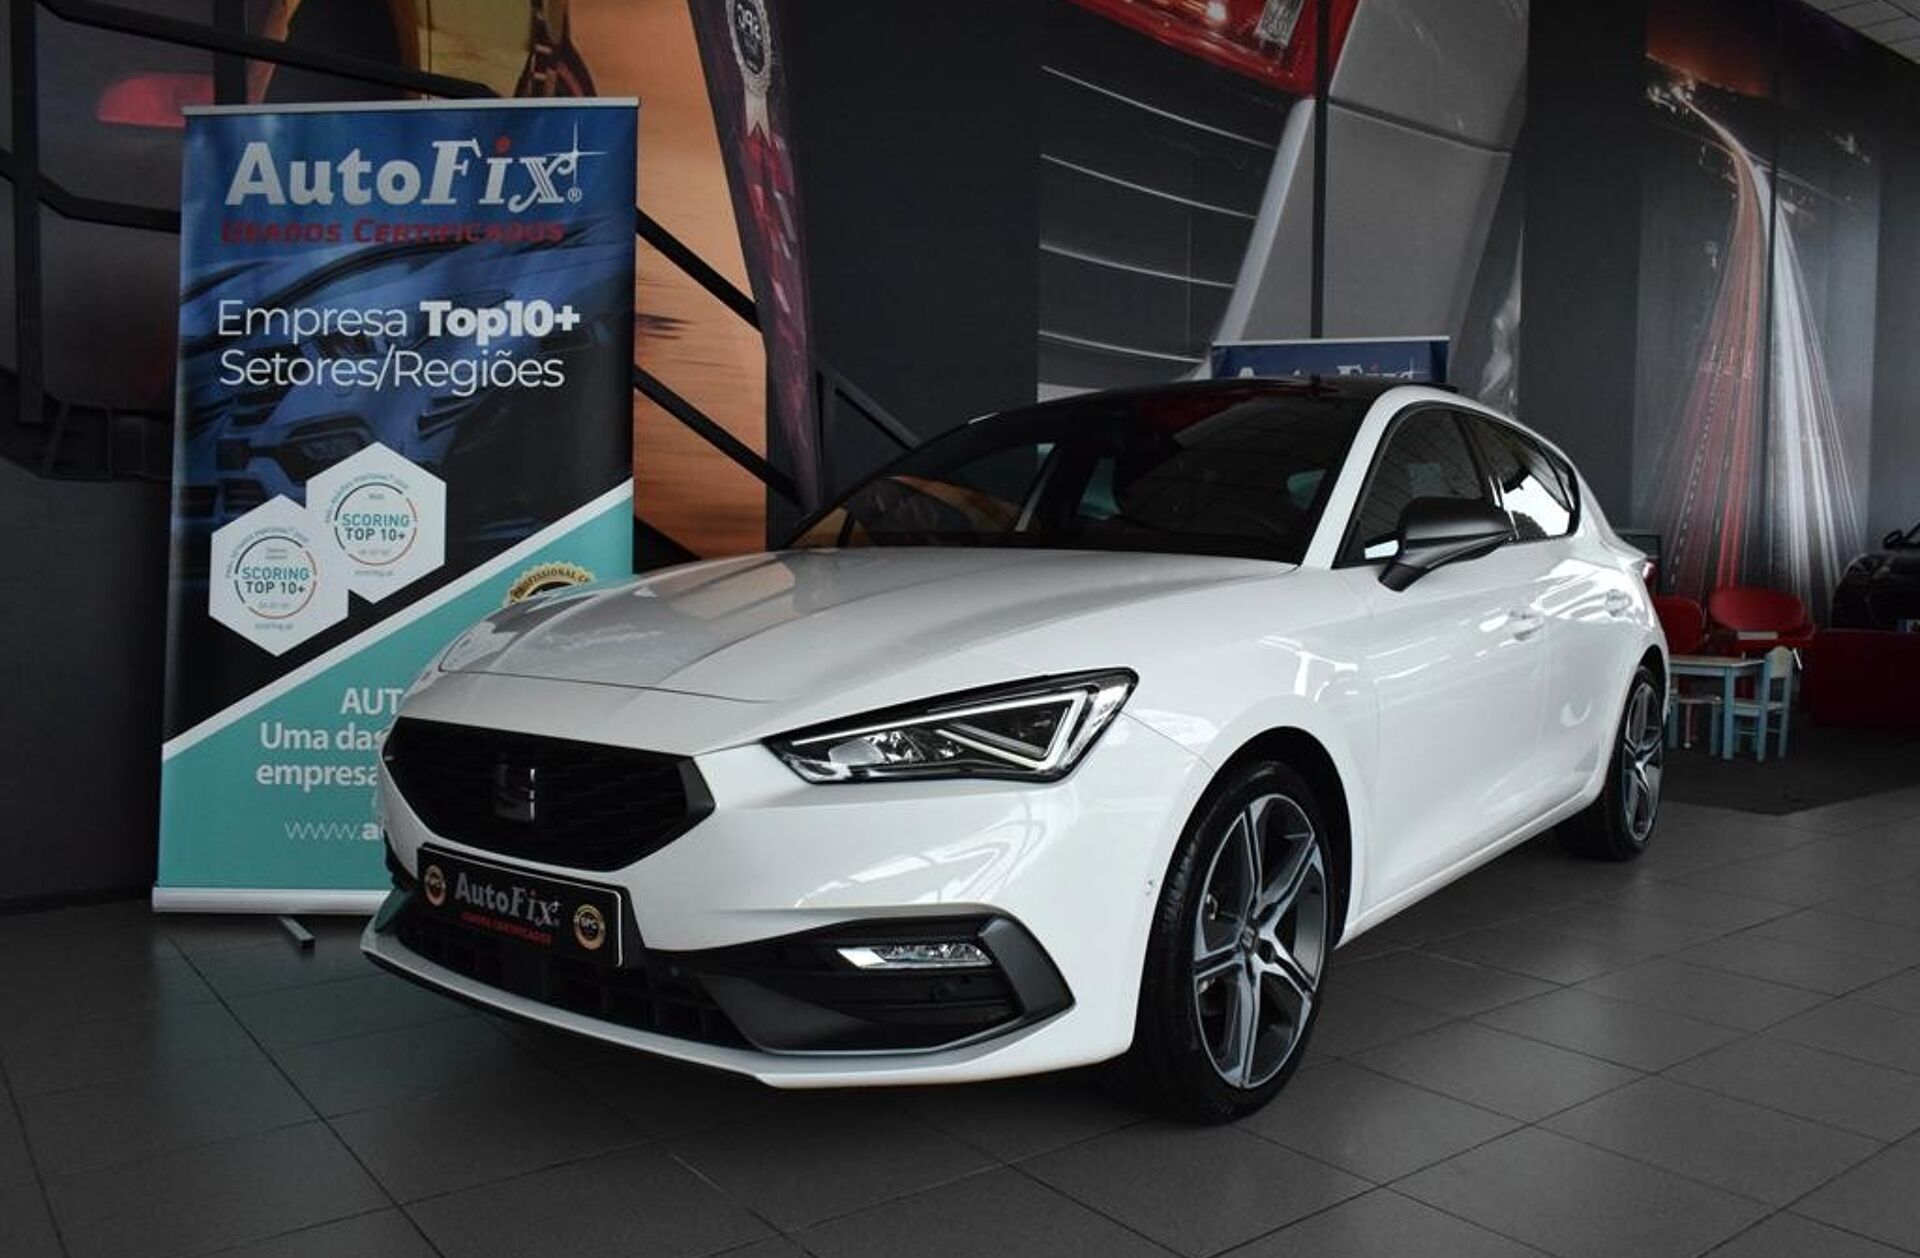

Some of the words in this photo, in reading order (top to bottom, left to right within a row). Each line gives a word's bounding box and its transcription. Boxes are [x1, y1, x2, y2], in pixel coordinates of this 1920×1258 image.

[353, 217, 565, 243] CERTIFICADOS
[217, 299, 407, 341] Empresa
[420, 299, 580, 346] Top10+
[219, 343, 566, 396] Setores/Regiões
[342, 513, 410, 527] SCORING
[345, 527, 376, 542] TOP
[381, 528, 406, 543] 10+
[241, 566, 310, 581] SCORING
[245, 581, 277, 595] TOP
[281, 582, 306, 596] 10+
[260, 722, 329, 750] Uma
